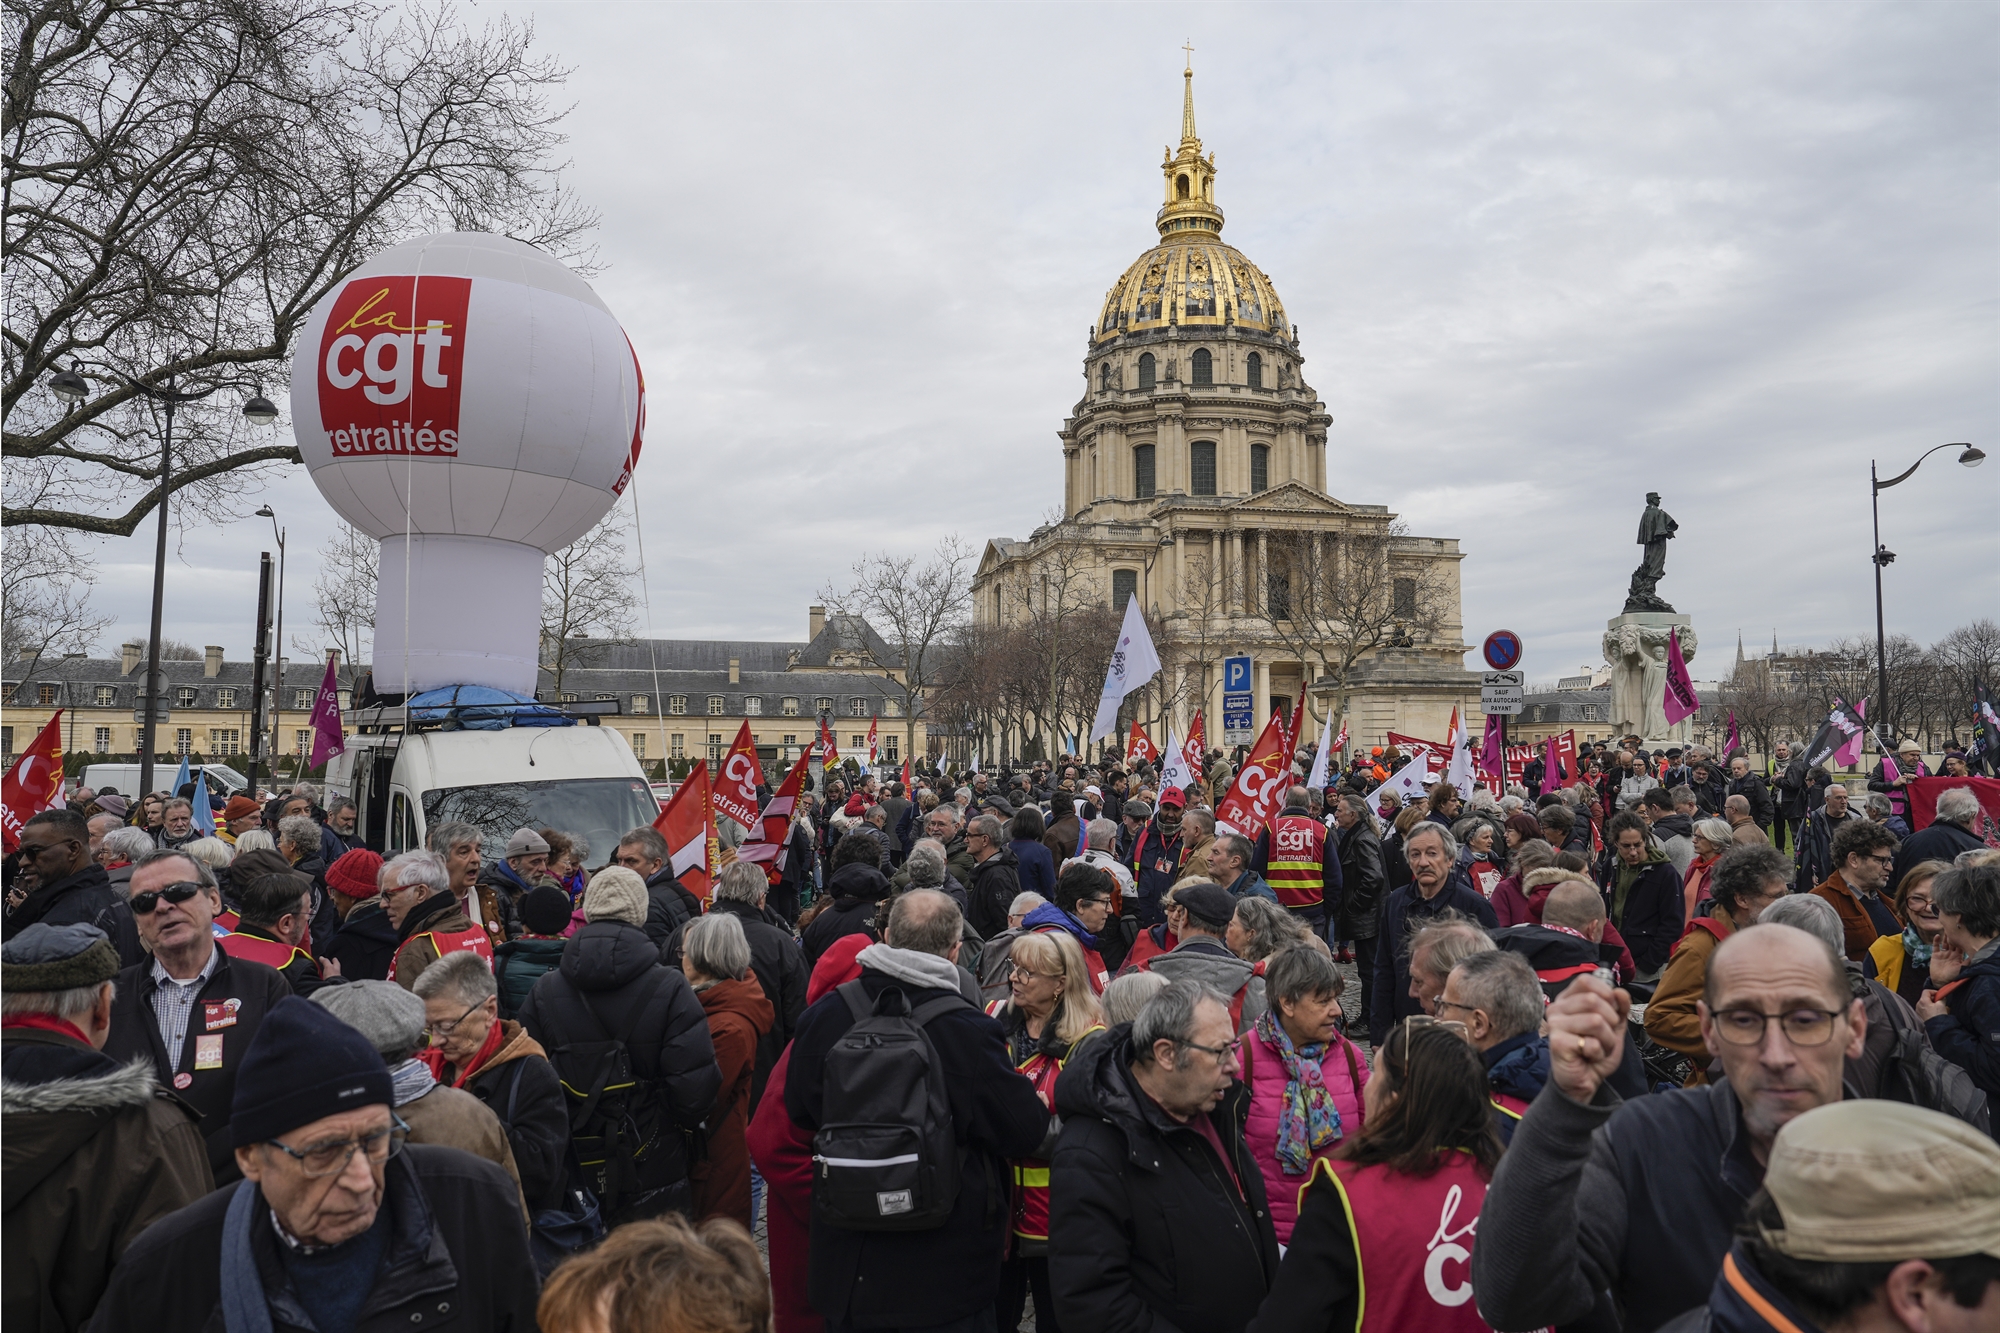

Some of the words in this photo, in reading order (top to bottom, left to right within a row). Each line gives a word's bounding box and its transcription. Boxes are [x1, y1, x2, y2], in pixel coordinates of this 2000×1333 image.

[336, 287, 453, 334] la
[325, 320, 452, 405] cgt
[325, 419, 459, 453] retraités
[1231, 663, 1244, 687] P
[1279, 819, 1306, 832] la
[1277, 828, 1313, 851] cgt
[206, 1007, 219, 1015] cgt
[206, 1016, 237, 1029] retraités
[197, 1048, 222, 1062] cgt
